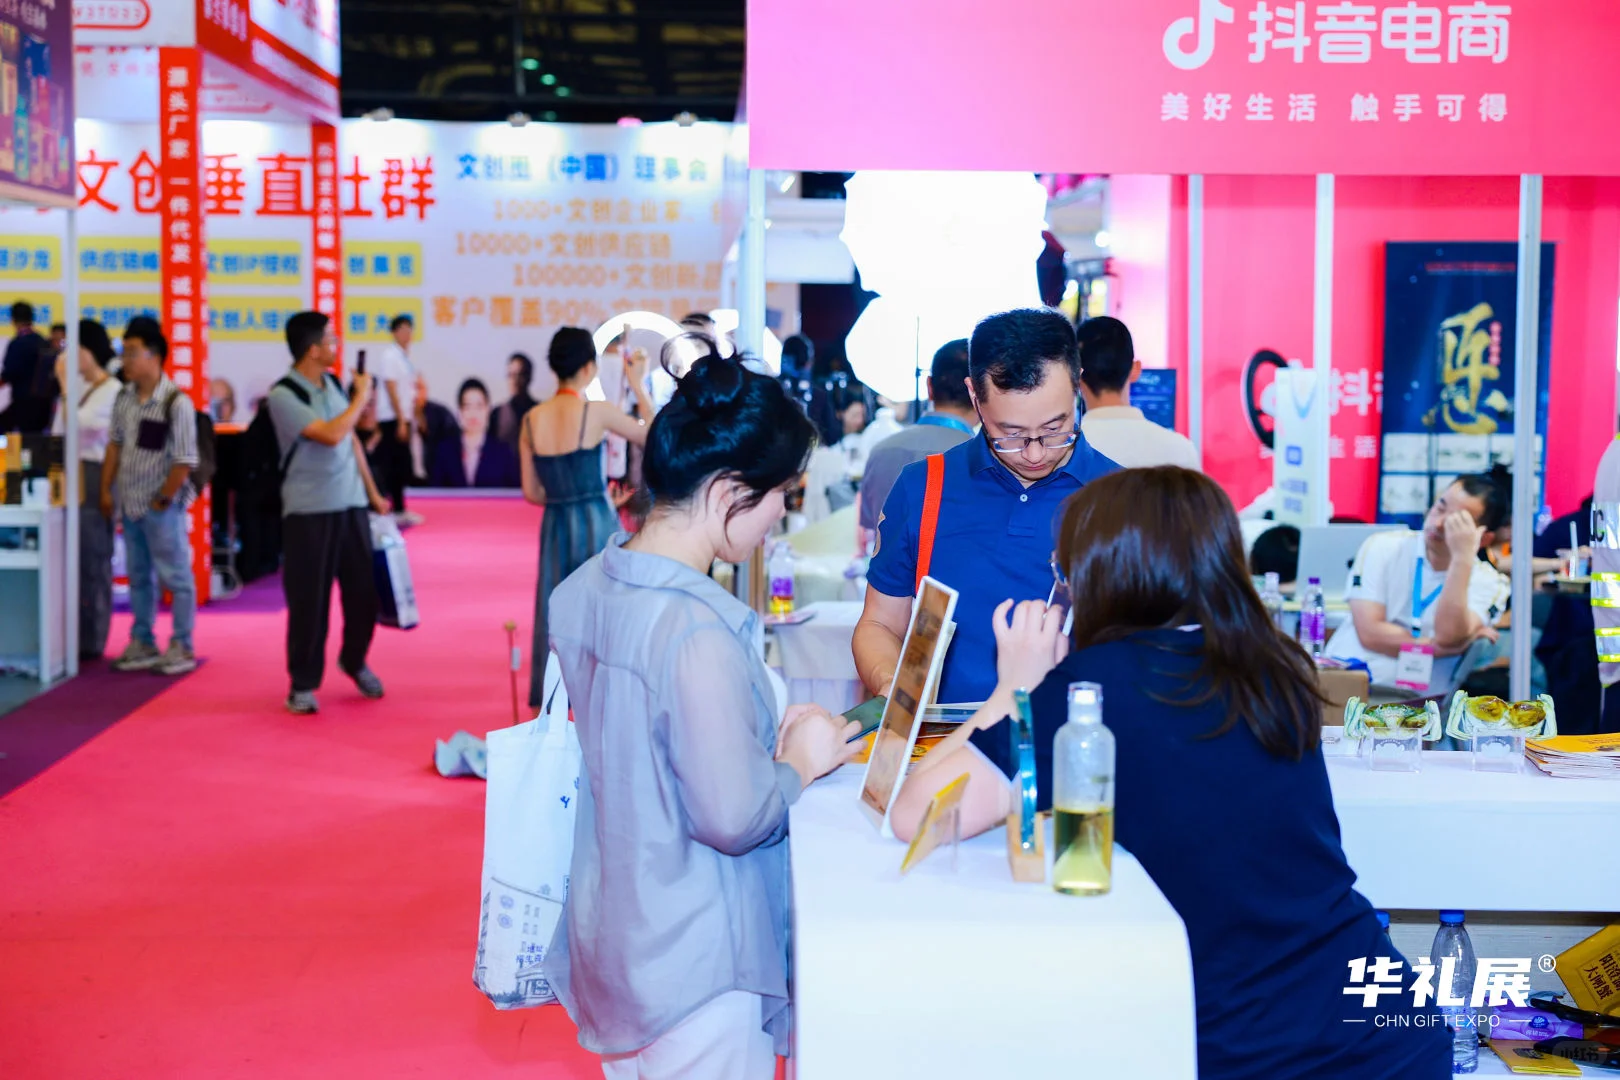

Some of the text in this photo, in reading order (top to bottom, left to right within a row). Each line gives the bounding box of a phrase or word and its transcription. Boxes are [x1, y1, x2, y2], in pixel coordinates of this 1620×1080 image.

[1248, 0, 1512, 64] 抖音电商
[1160, 92, 1508, 123] 美好生活 触手可得
